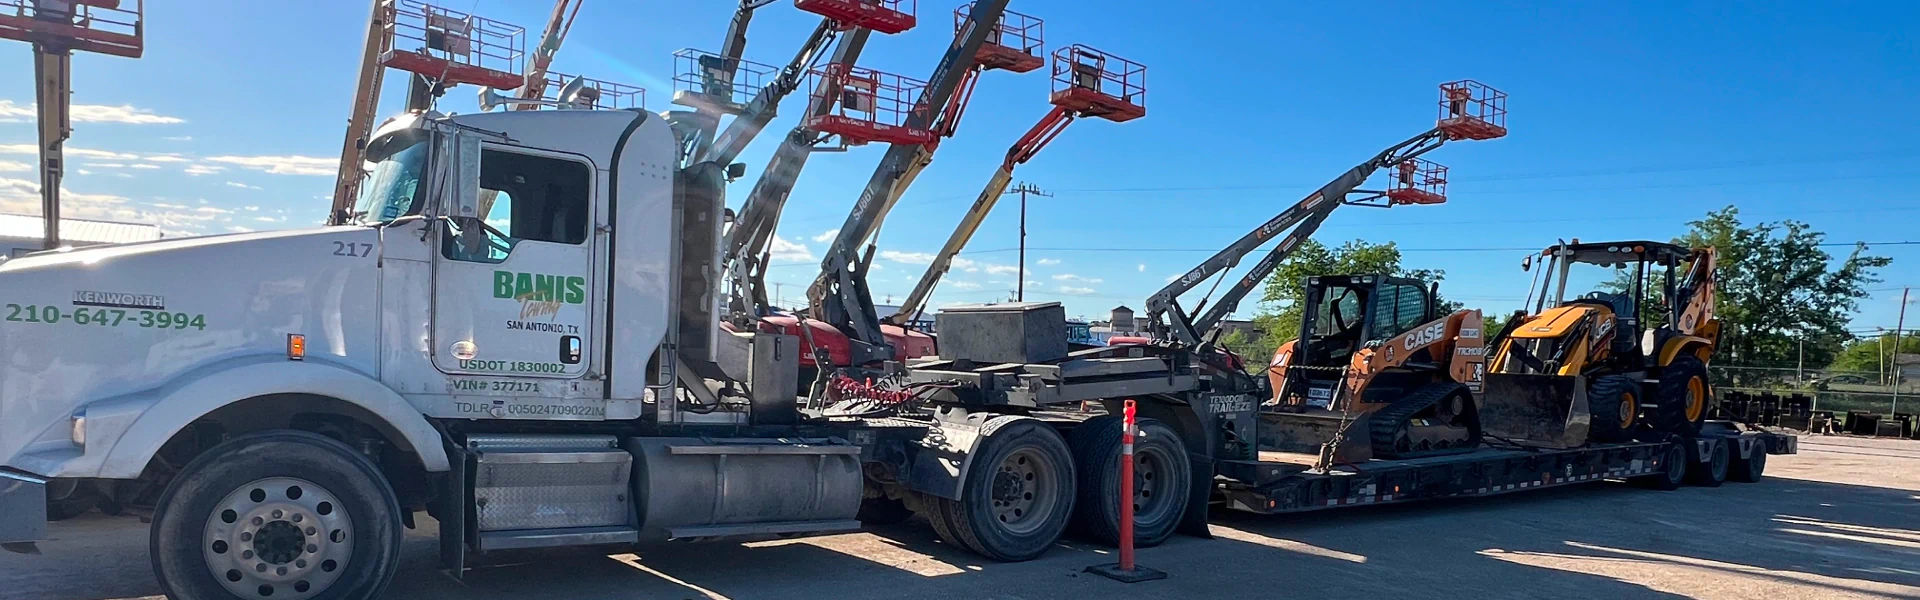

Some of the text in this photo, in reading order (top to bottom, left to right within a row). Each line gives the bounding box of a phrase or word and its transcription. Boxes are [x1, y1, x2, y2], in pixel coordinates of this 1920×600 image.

[333, 240, 373, 258] 217
[493, 270, 585, 304] BANIS
[73, 290, 165, 307] KENWORTH
[5, 303, 207, 331] 210-647-3994
[506, 320, 579, 335] SAN ANTONIO, TX
[1596, 318, 1612, 339] JCB
[1404, 322, 1444, 351] CASE
[459, 358, 566, 373] USDOT 1830002
[452, 379, 540, 393] VIN# 377171
[455, 402, 489, 414] TDLR
[1209, 402, 1251, 413] TRAIL-EZE
